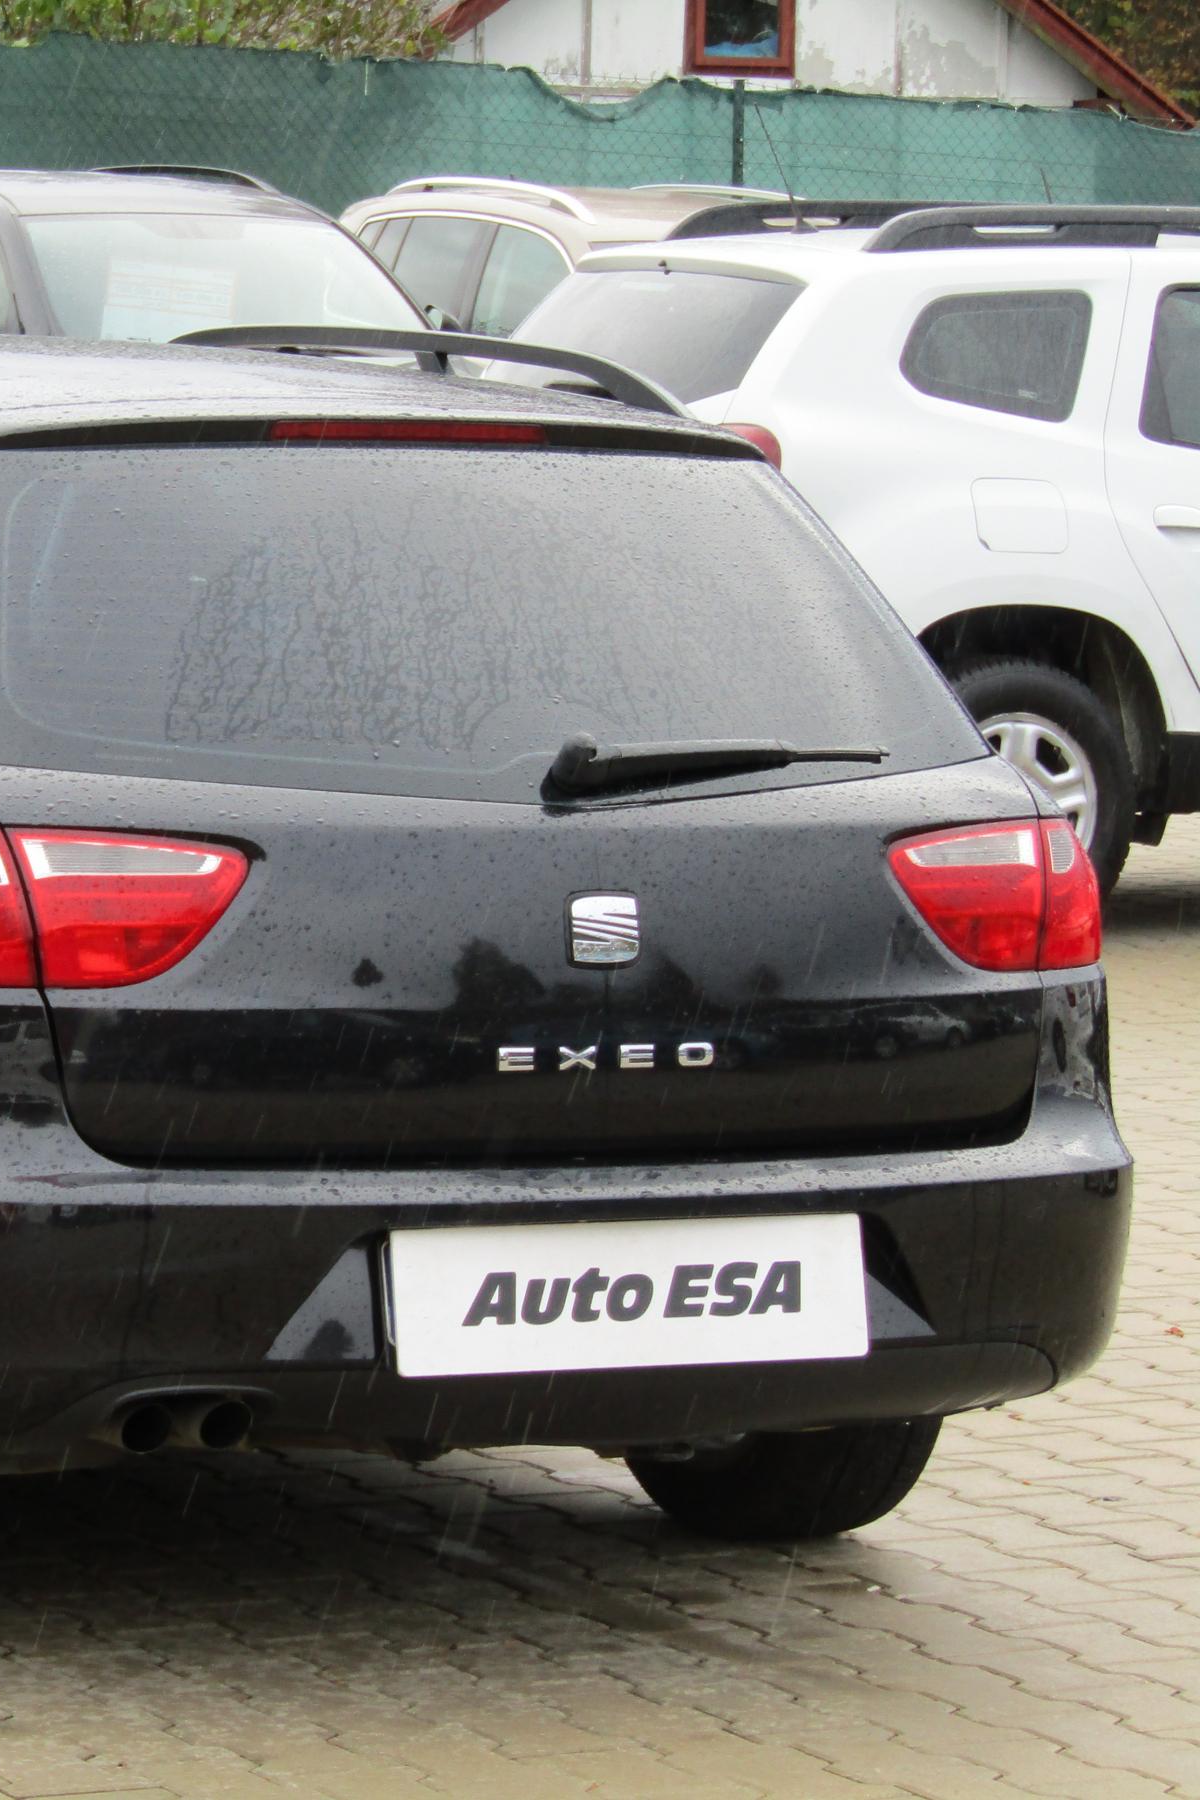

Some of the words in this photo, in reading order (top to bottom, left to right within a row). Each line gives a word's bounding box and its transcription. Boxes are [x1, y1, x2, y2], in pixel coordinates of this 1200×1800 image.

[498, 1041, 715, 1072] EXEO
[461, 1267, 655, 1328] Auto
[662, 1260, 802, 1320] ESA
